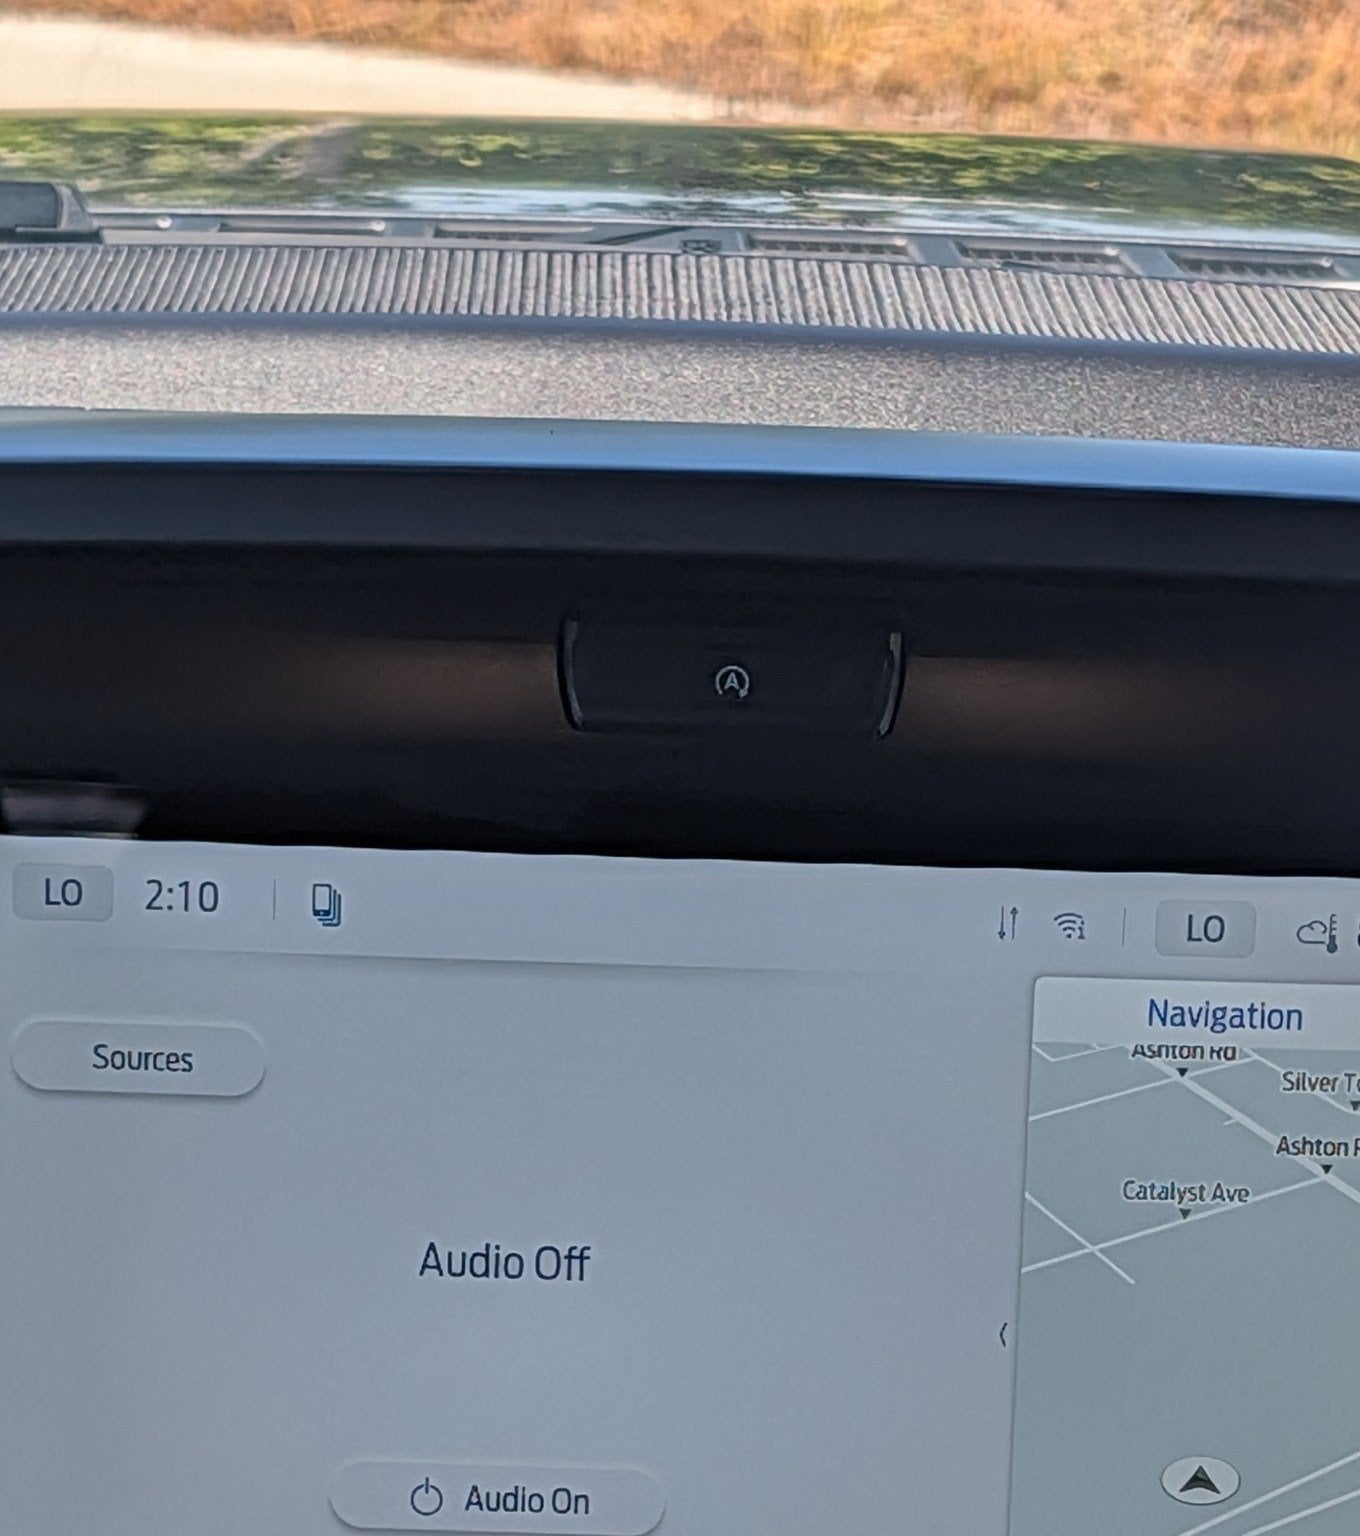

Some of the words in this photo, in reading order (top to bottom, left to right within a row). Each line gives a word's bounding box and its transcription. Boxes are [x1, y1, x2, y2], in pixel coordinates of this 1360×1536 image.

[43, 877, 83, 907] LO
[144, 879, 220, 913] 2:10
[1186, 913, 1226, 943] LO
[1147, 998, 1304, 1034] Navigation
[91, 1042, 195, 1075] Sources
[1281, 1070, 1339, 1093] Silver
[1275, 1135, 1349, 1157] Ashton
[1122, 1179, 1207, 1206] Catalyst
[1210, 1181, 1251, 1203] Ave
[418, 1241, 525, 1281] Audio
[533, 1244, 592, 1283] Off
[464, 1484, 545, 1514] Audio
[551, 1486, 590, 1515] On
